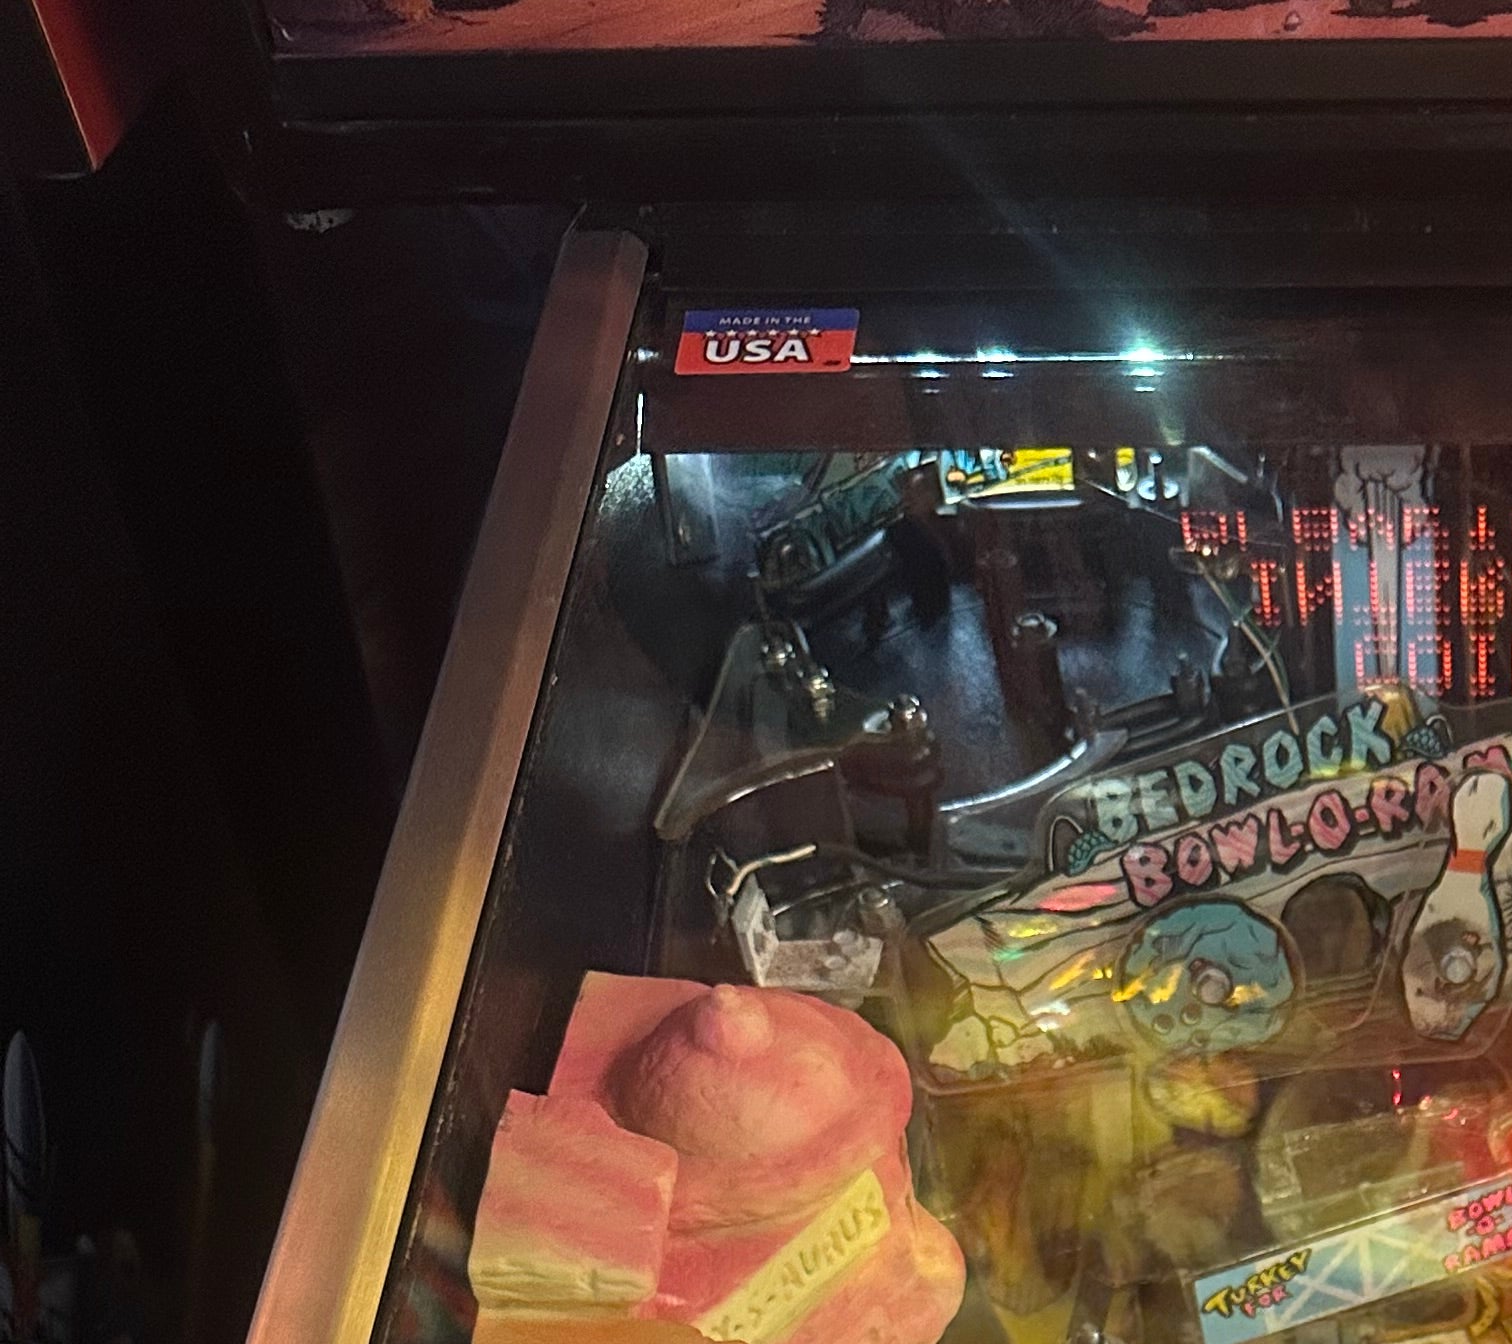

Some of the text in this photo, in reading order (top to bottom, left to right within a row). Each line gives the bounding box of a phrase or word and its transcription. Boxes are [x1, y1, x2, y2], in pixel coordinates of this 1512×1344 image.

[719, 315, 811, 326] MADE IN THE
[704, 338, 811, 364] USA
[1095, 701, 1395, 844] BEDROCK
[1202, 1247, 1313, 1318] TURKEY
[1242, 1284, 1294, 1318] FOR
